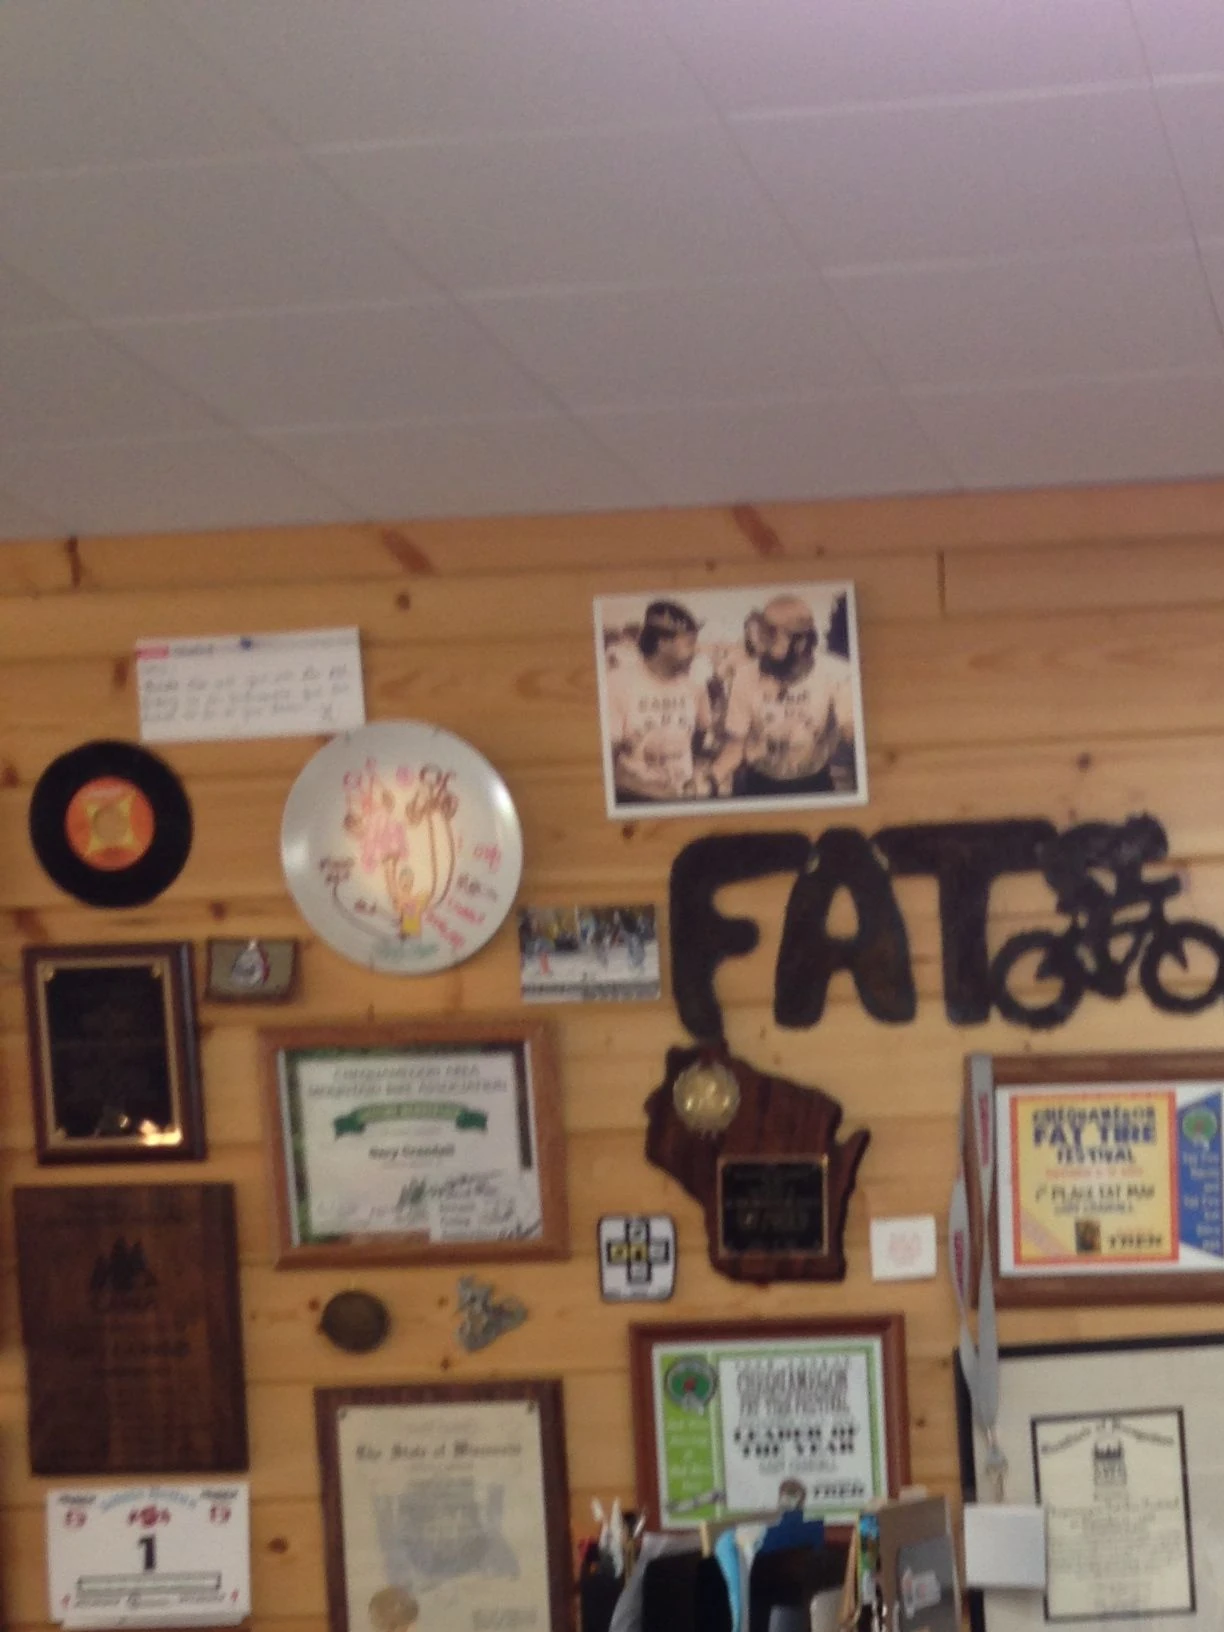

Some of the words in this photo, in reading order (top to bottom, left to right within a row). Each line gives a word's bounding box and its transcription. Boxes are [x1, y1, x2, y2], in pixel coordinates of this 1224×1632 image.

[668, 817, 1058, 1041] FAT
[1057, 1147, 1135, 1165] FESTIVAL
[734, 1424, 824, 1443] LEADER
[793, 1440, 856, 1457] YEAR
[138, 1533, 157, 1571] 1
